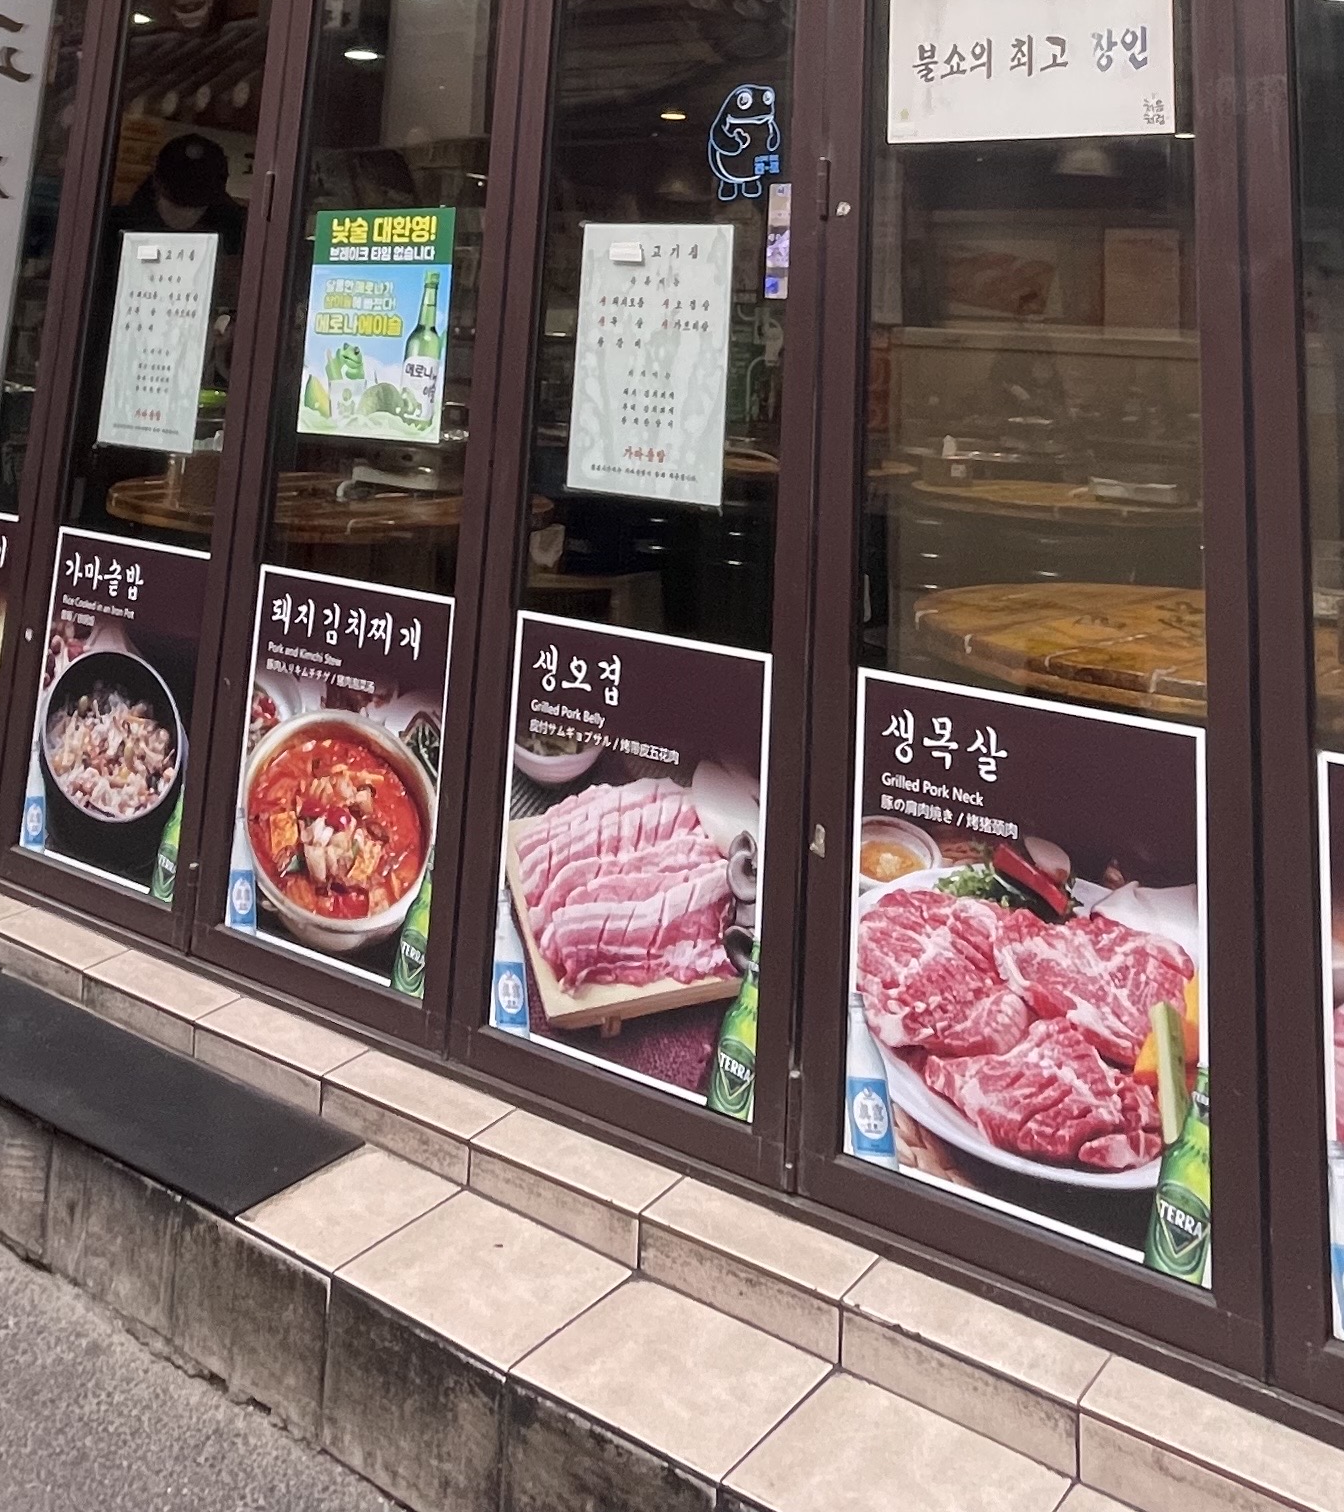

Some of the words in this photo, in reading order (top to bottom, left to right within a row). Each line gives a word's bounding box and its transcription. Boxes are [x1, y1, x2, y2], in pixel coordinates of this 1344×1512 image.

[1009, 34, 1069, 77] 최고
[1091, 25, 1149, 73] 장인
[331, 216, 369, 244] 낮술
[372, 215, 438, 244] 대환영!
[329, 245, 369, 262] 브레이크
[370, 245, 392, 261] 타임
[640, 243, 699, 260] 고기집
[65, 552, 144, 601] 가마솥밥
[272, 593, 422, 661] 돼지김치찌개
[530, 699, 560, 717] Grilled
[561, 704, 582, 721] Pork
[583, 710, 606, 729] Belly
[881, 708, 1008, 783] 생목살
[881, 772, 920, 793] Grilled
[923, 779, 950, 800] Pork
[952, 786, 985, 808] Neck
[719, 1051, 754, 1083] TERRA
[1158, 1198, 1203, 1240] TERRA
